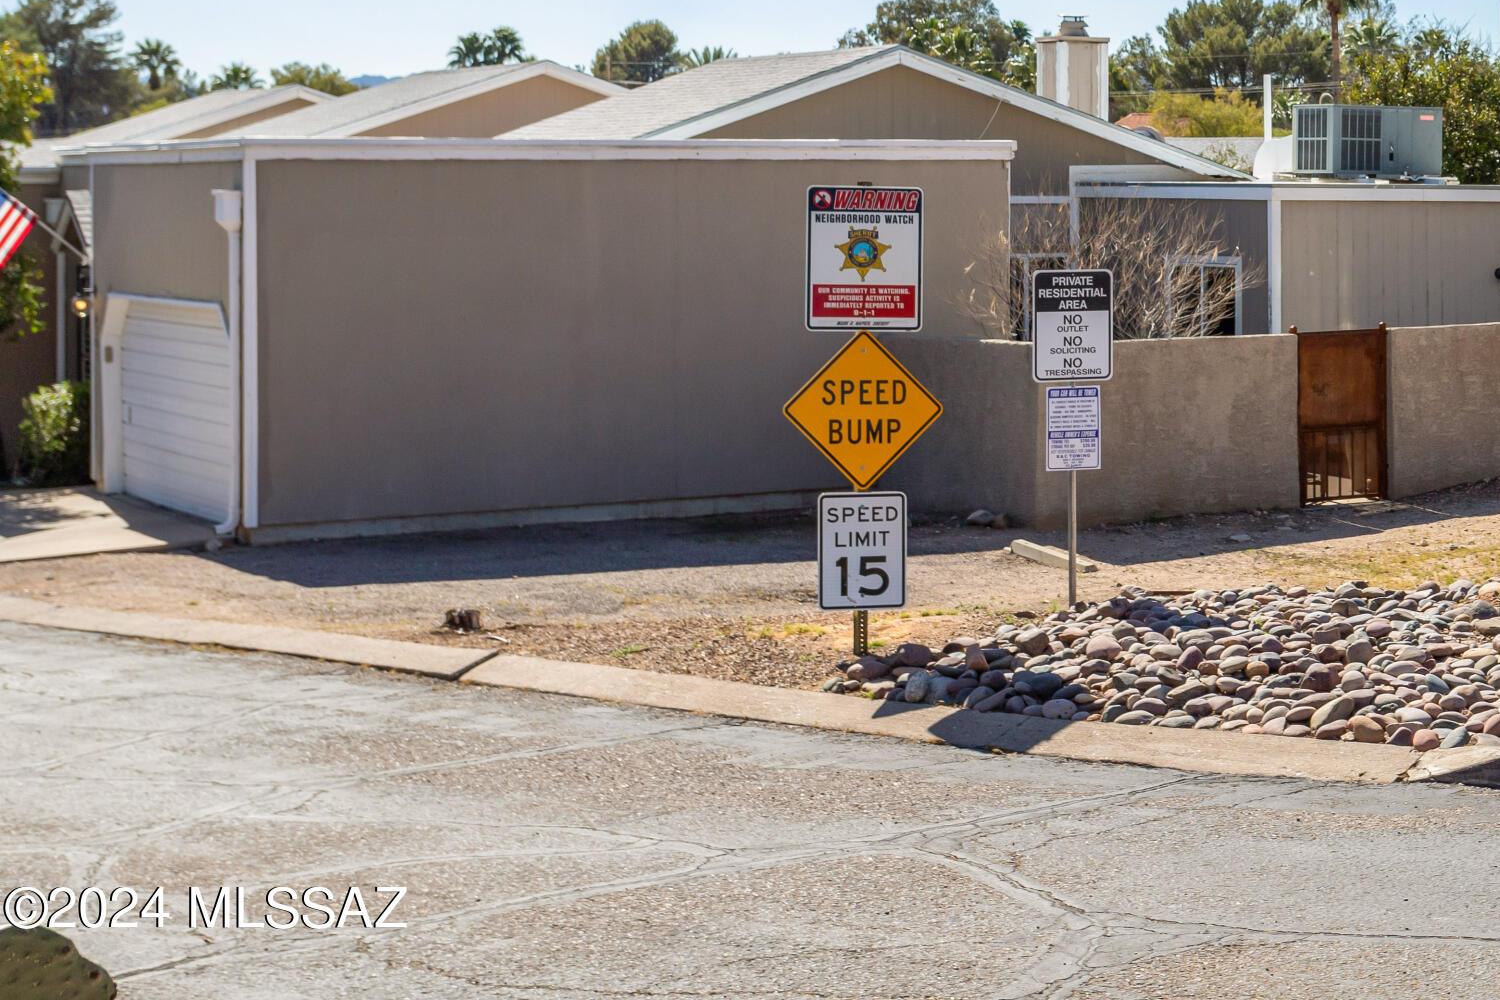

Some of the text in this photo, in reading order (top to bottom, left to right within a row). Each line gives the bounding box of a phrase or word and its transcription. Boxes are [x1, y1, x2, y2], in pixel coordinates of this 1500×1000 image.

[833, 189, 919, 211] WARNING
[815, 213, 914, 225] NEIGHBORHOOD WATCH
[1052, 276, 1094, 286] PRIVATE
[828, 294, 864, 302] SUSPICIOUS
[1038, 288, 1107, 299] RESIDENTIAL
[1058, 300, 1087, 309] AREA
[1063, 314, 1083, 325] NO
[1056, 325, 1089, 333] OUTLET
[1063, 336, 1083, 347] NO
[1049, 347, 1097, 355] SOLICITING
[1063, 357, 1083, 368] NO
[1044, 368, 1102, 376] TRESPASSING
[821, 379, 907, 406] SPEED
[828, 418, 902, 445] BUMP
[826, 506, 899, 523] SPEED
[834, 531, 890, 547] LIMIT
[835, 555, 890, 597] 15
